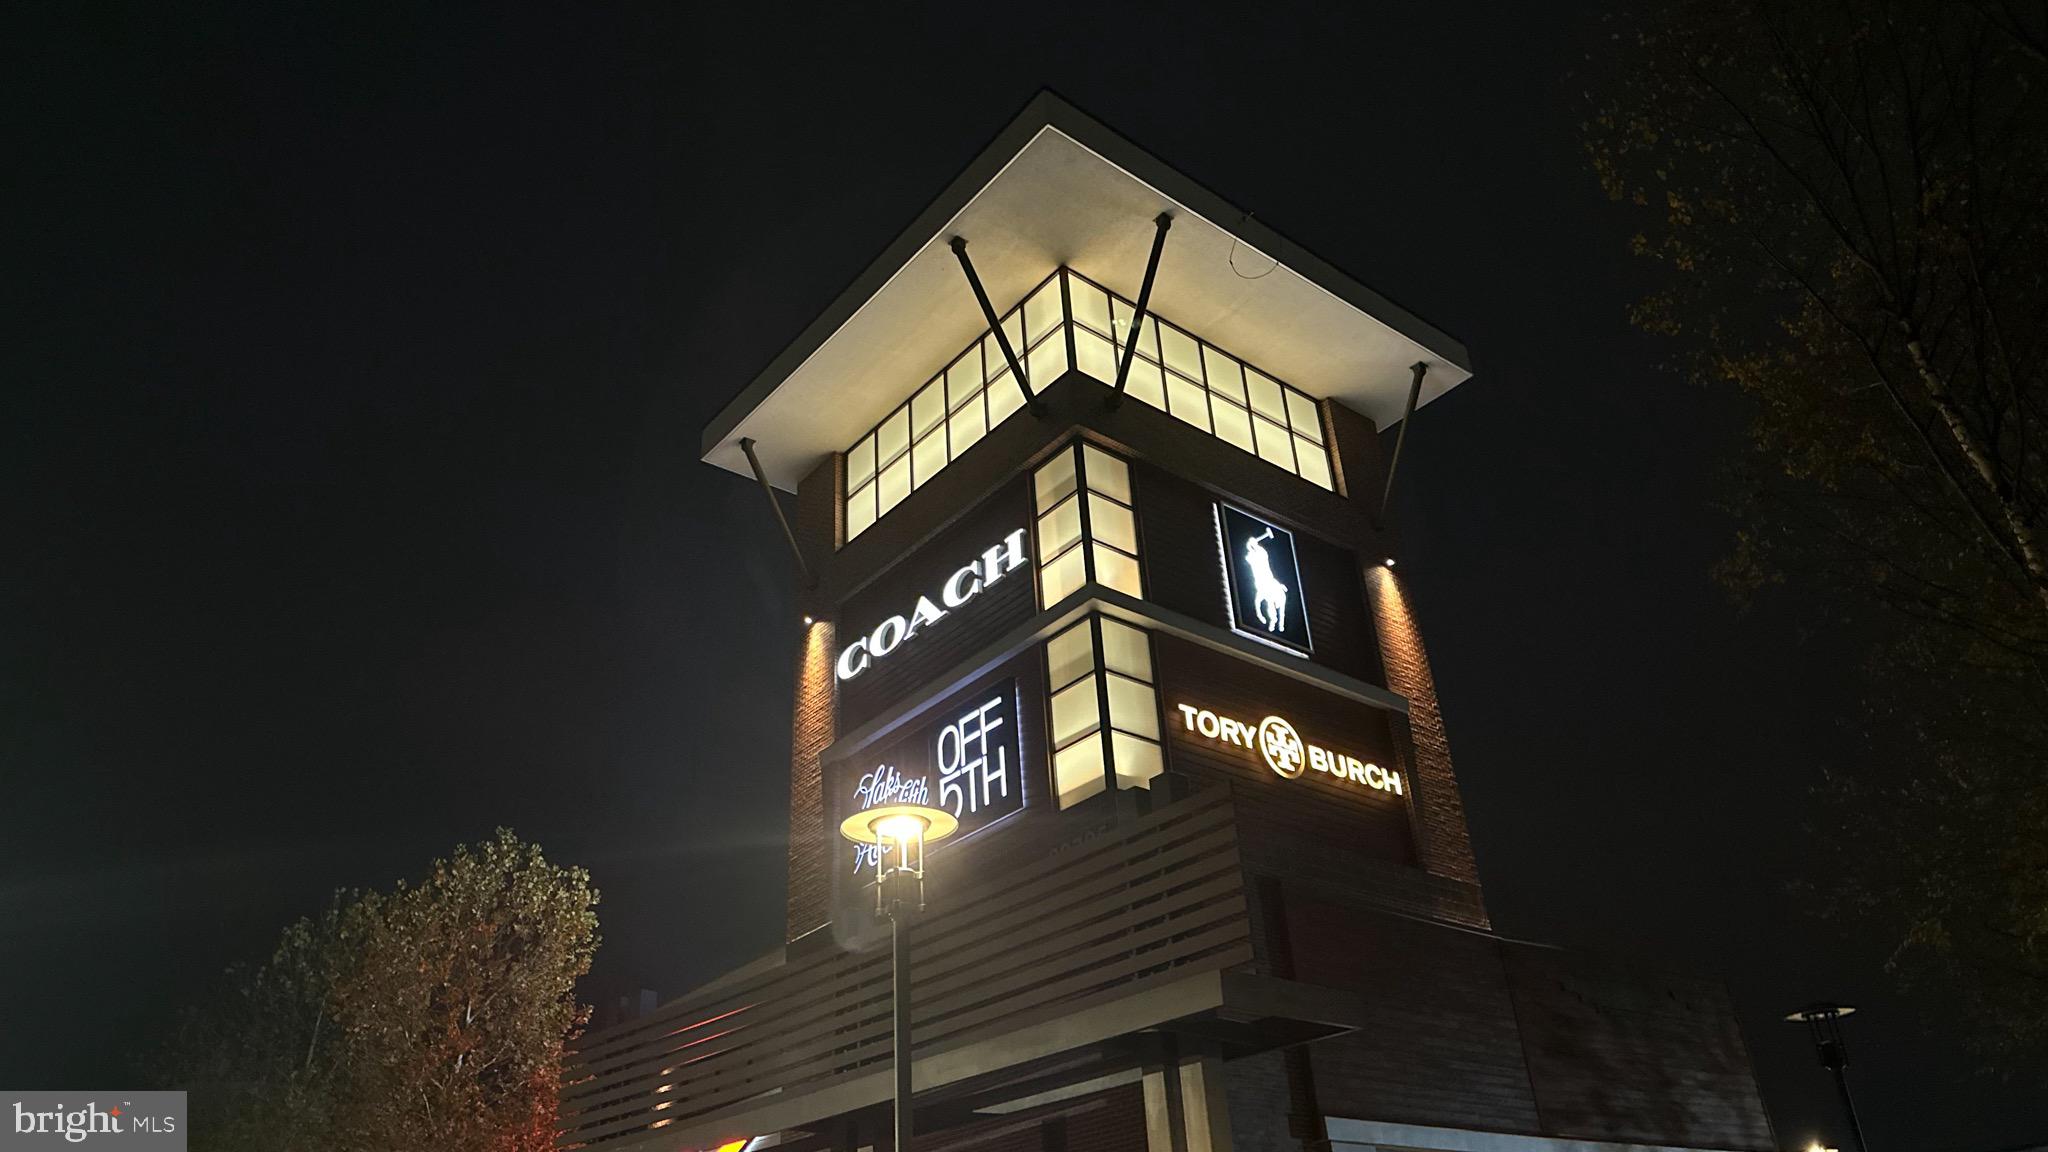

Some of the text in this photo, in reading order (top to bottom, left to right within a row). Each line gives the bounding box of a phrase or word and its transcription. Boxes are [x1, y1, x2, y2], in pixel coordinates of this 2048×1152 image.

[837, 528, 1029, 680] COACH
[937, 696, 1003, 775] OFF
[1178, 703, 1403, 796] TORY BURCH
